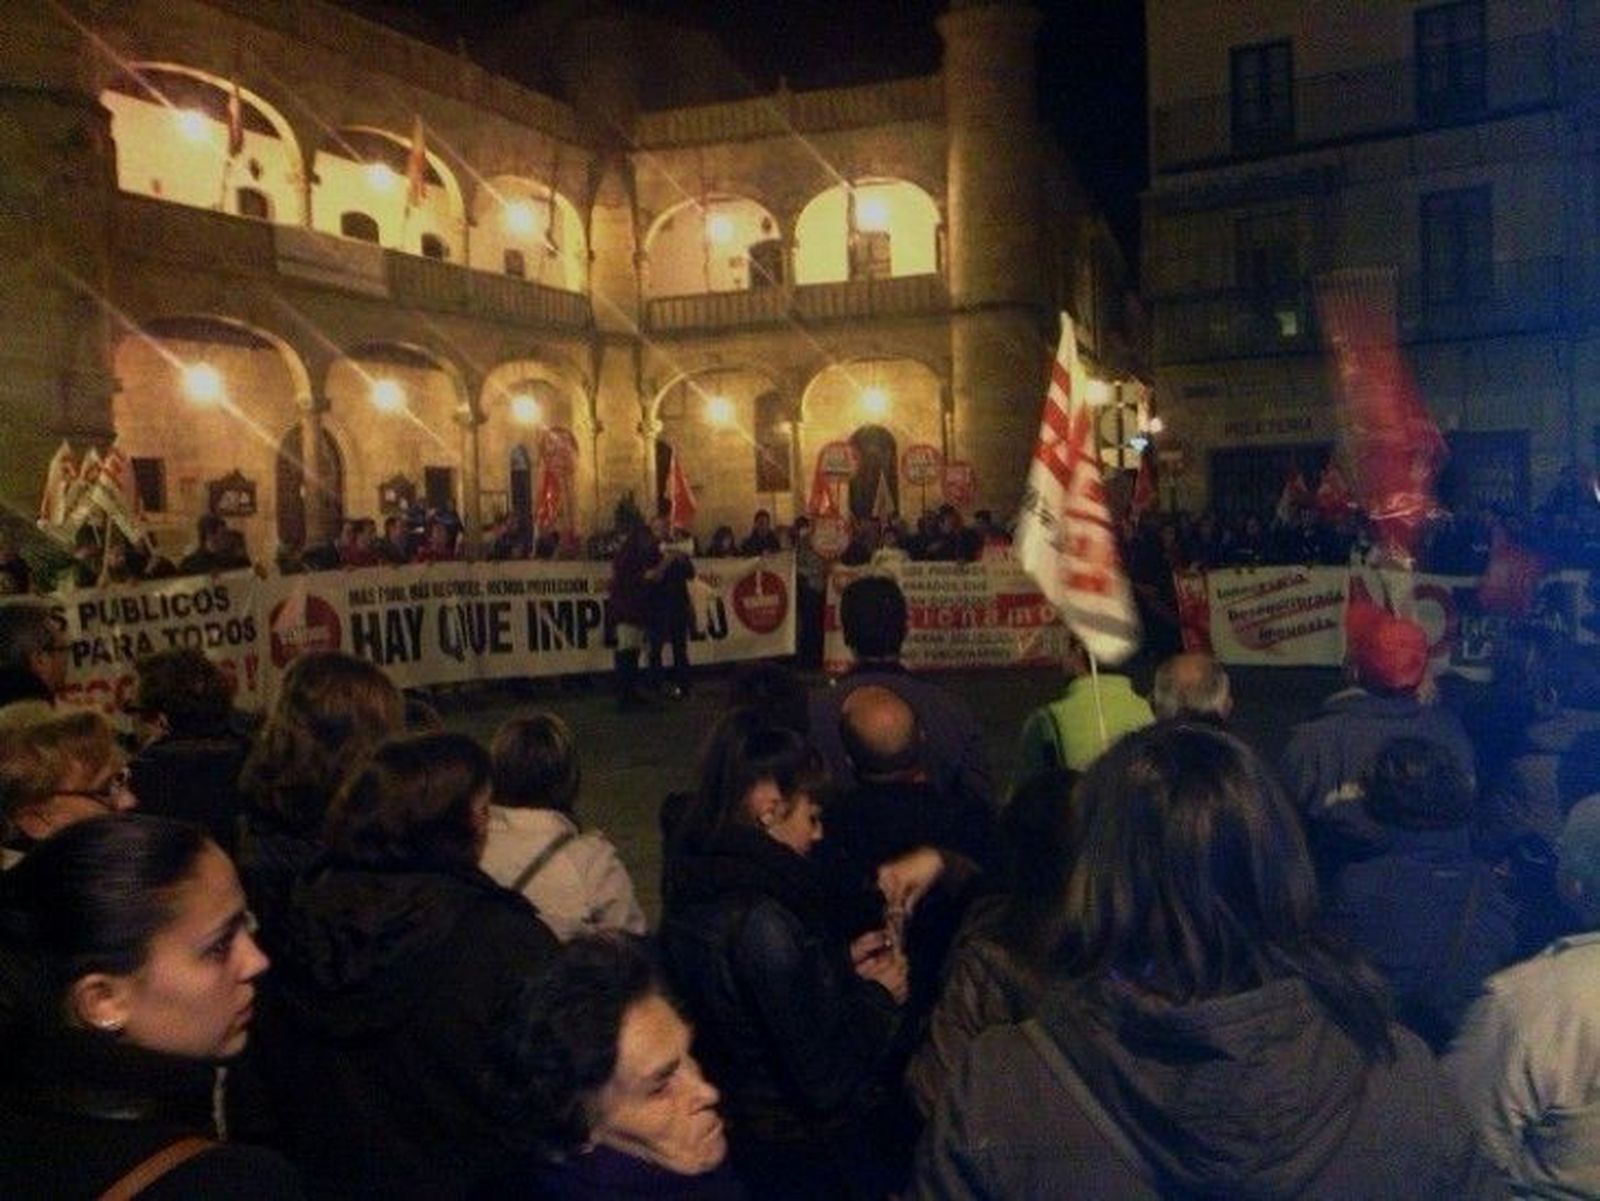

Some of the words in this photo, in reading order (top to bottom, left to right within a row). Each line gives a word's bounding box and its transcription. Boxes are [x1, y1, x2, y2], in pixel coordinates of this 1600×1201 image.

[72, 630, 153, 667] PARA
[164, 616, 257, 649] TODOS
[351, 605, 425, 666] HAY
[439, 601, 514, 662] QUE
